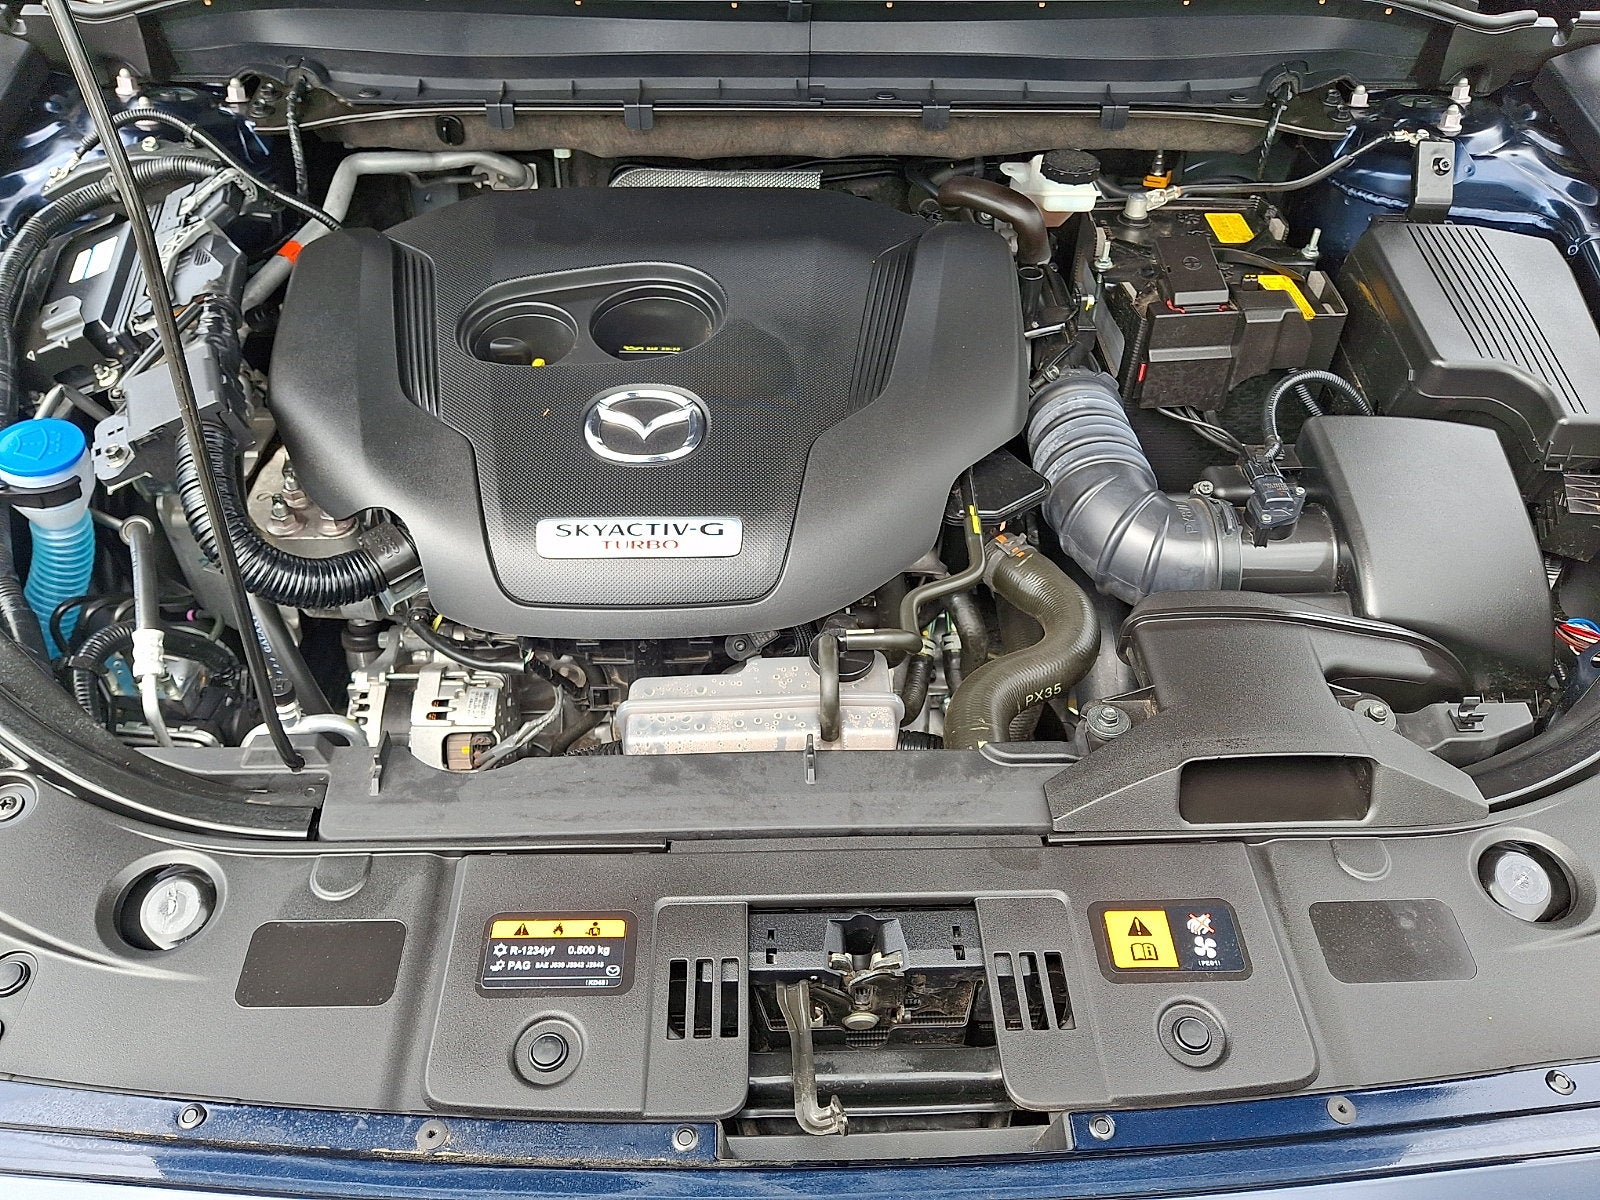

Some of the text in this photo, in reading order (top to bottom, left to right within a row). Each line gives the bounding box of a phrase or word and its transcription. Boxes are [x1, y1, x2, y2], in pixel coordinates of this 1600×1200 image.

[555, 523, 724, 537] SKYACTIV-G
[601, 540, 679, 549] TURBO
[1025, 682, 1062, 706] PX35
[509, 945, 611, 957] R-1234yf 0.500 kg
[507, 960, 531, 971] PAG
